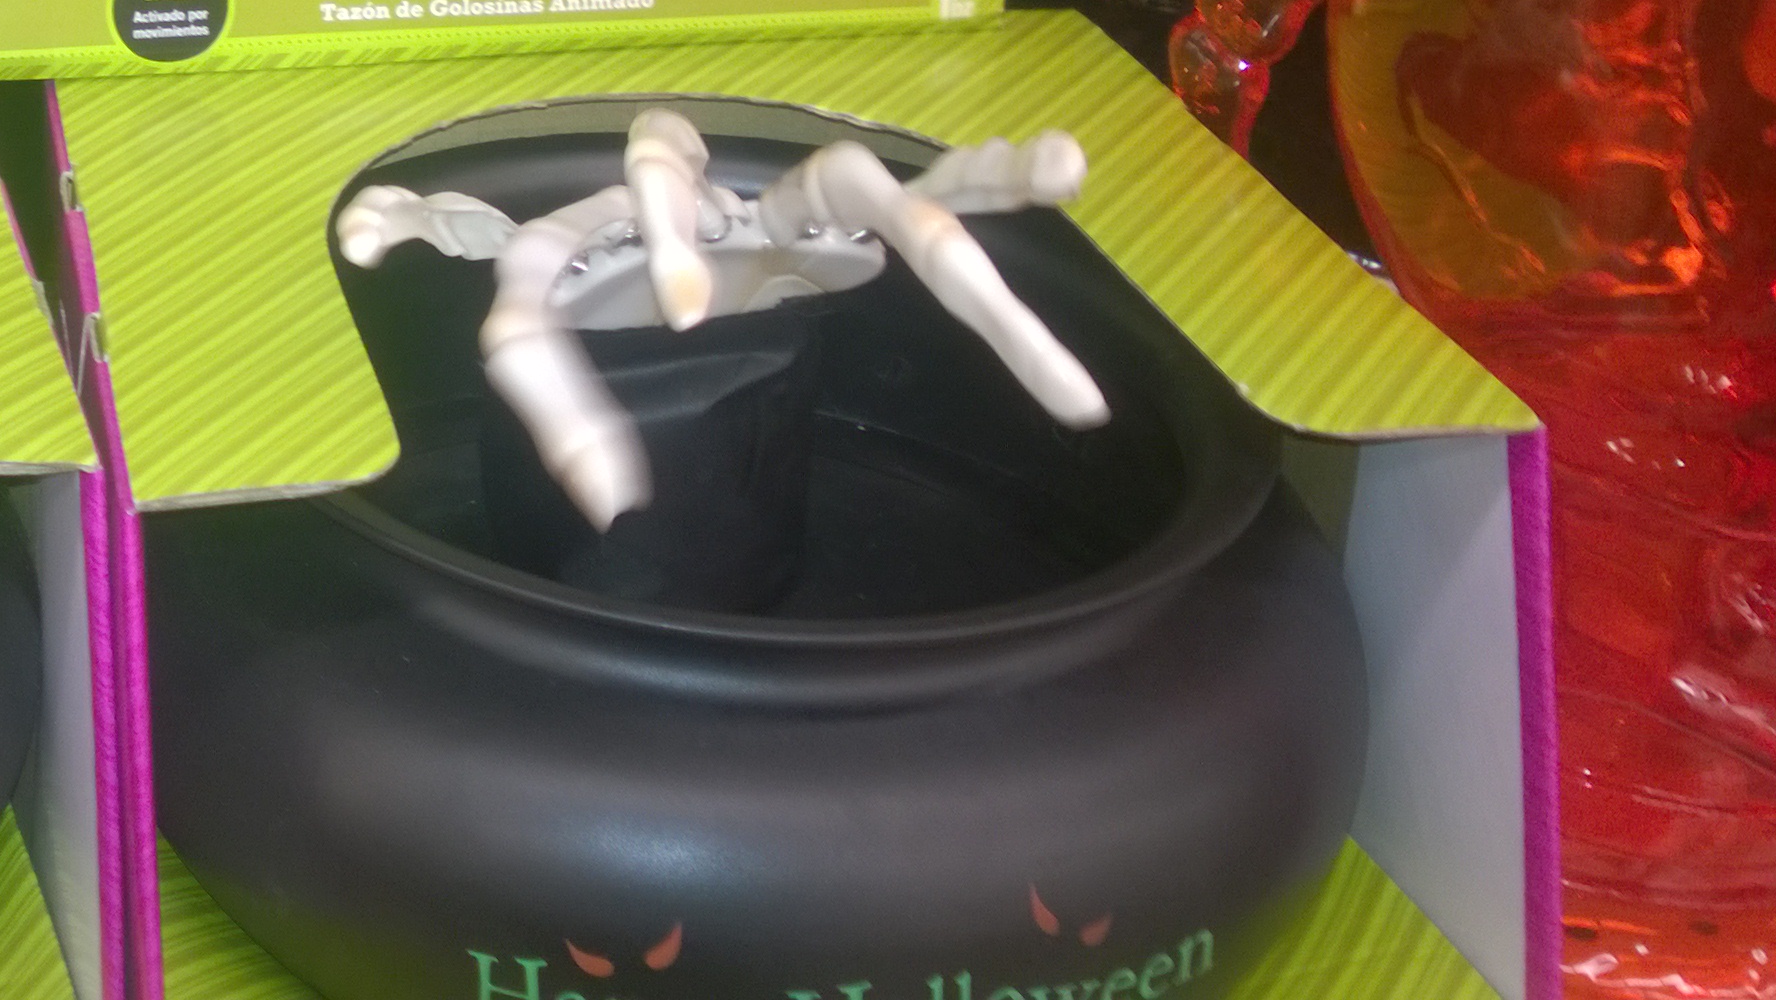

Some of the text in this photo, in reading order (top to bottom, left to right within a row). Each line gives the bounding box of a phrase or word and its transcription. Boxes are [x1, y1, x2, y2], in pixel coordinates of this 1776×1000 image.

[132, 9, 210, 24] Activado por
[318, 1, 392, 23] Tazón
[395, 0, 426, 19] de
[131, 24, 211, 40] movimientos
